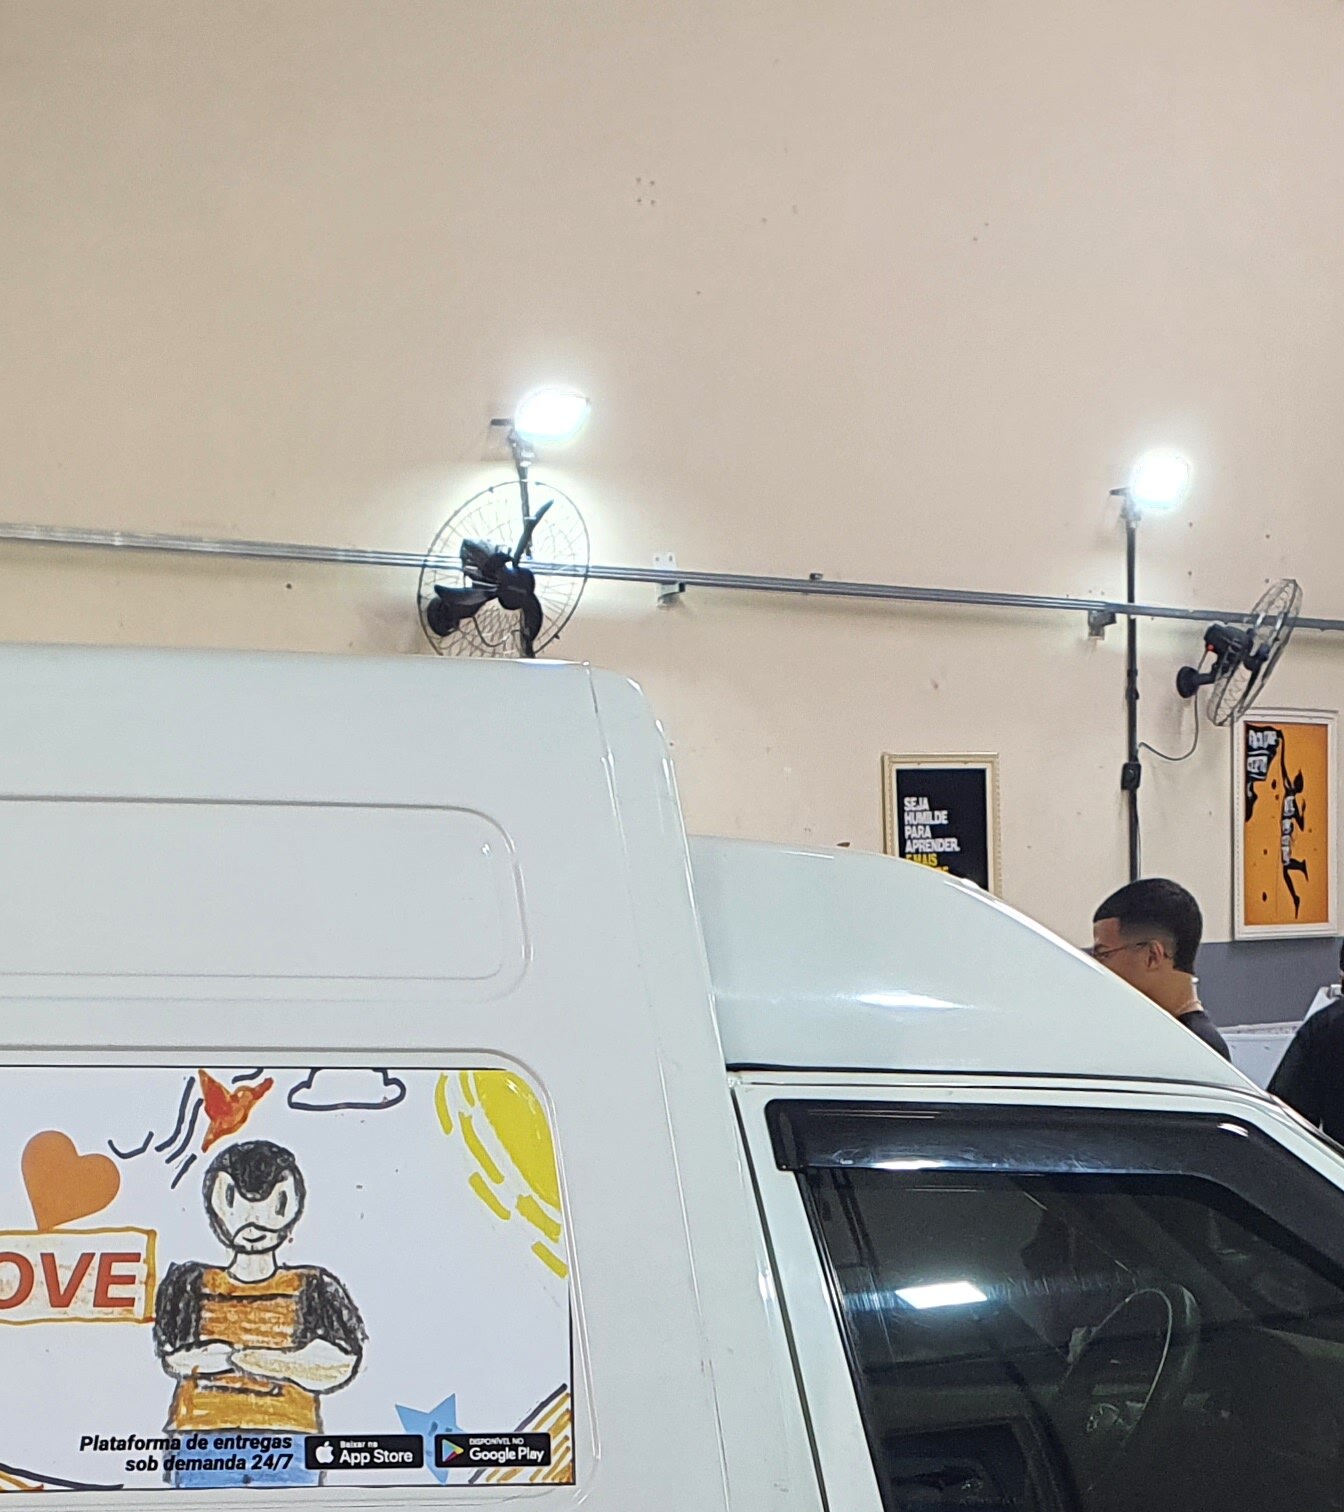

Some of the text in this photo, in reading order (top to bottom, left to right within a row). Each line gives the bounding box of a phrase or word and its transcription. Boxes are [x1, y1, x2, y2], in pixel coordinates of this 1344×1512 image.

[903, 797, 930, 811] SEJA
[903, 810, 949, 825] HUMILDE
[904, 825, 932, 839] PARA
[80, 1434, 293, 1453] Plataforma de entregas
[340, 1441, 365, 1449] Baixar
[512, 1437, 524, 1445] NO
[340, 1449, 413, 1466] App Store
[469, 1447, 544, 1462] Google Play
[125, 1454, 294, 1471] sob demanda 24/7
